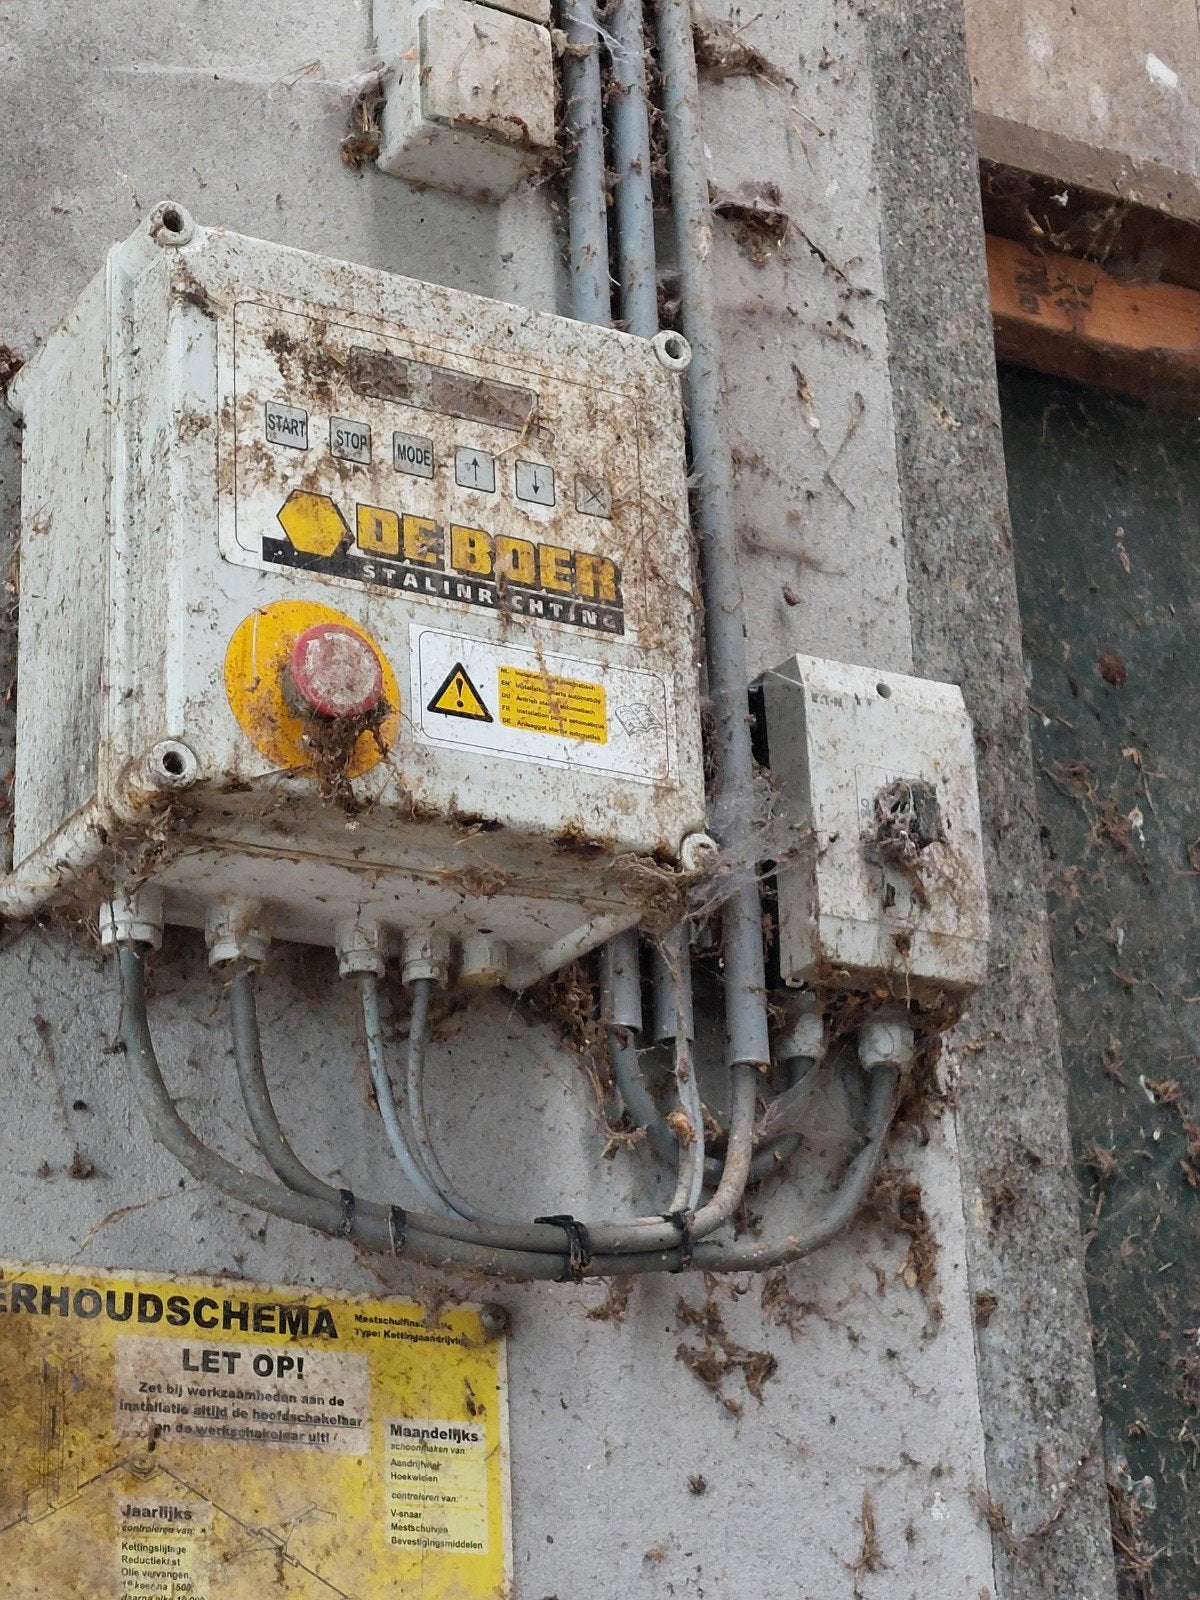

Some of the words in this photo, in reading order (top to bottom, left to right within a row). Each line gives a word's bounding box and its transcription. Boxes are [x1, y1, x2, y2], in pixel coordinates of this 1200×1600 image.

[268, 413, 305, 438] START
[336, 429, 367, 451] STOP
[397, 443, 431, 467] MODE
[356, 503, 445, 567] DE
[449, 523, 623, 603] BOER
[362, 564, 617, 629] STALINRCHTING
[181, 1348, 241, 1375] LET
[252, 1353, 304, 1379] OP!
[138, 1381, 162, 1394] Zet
[166, 1382, 183, 1398] bij
[187, 1385, 297, 1403] werkzaamheden
[300, 1395, 325, 1406] aan
[328, 1396, 345, 1407] de
[119, 1400, 189, 1415] installatie
[192, 1405, 228, 1420] altijd
[232, 1407, 249, 1419] de
[252, 1408, 363, 1427] hoofdschakelaar
[175, 1422, 192, 1434] de
[390, 1423, 479, 1443] Maandelijks
[122, 1504, 193, 1522] Jaarlijks
[390, 1509, 422, 1519] V-snaar
[121, 1568, 139, 1577] Olie
